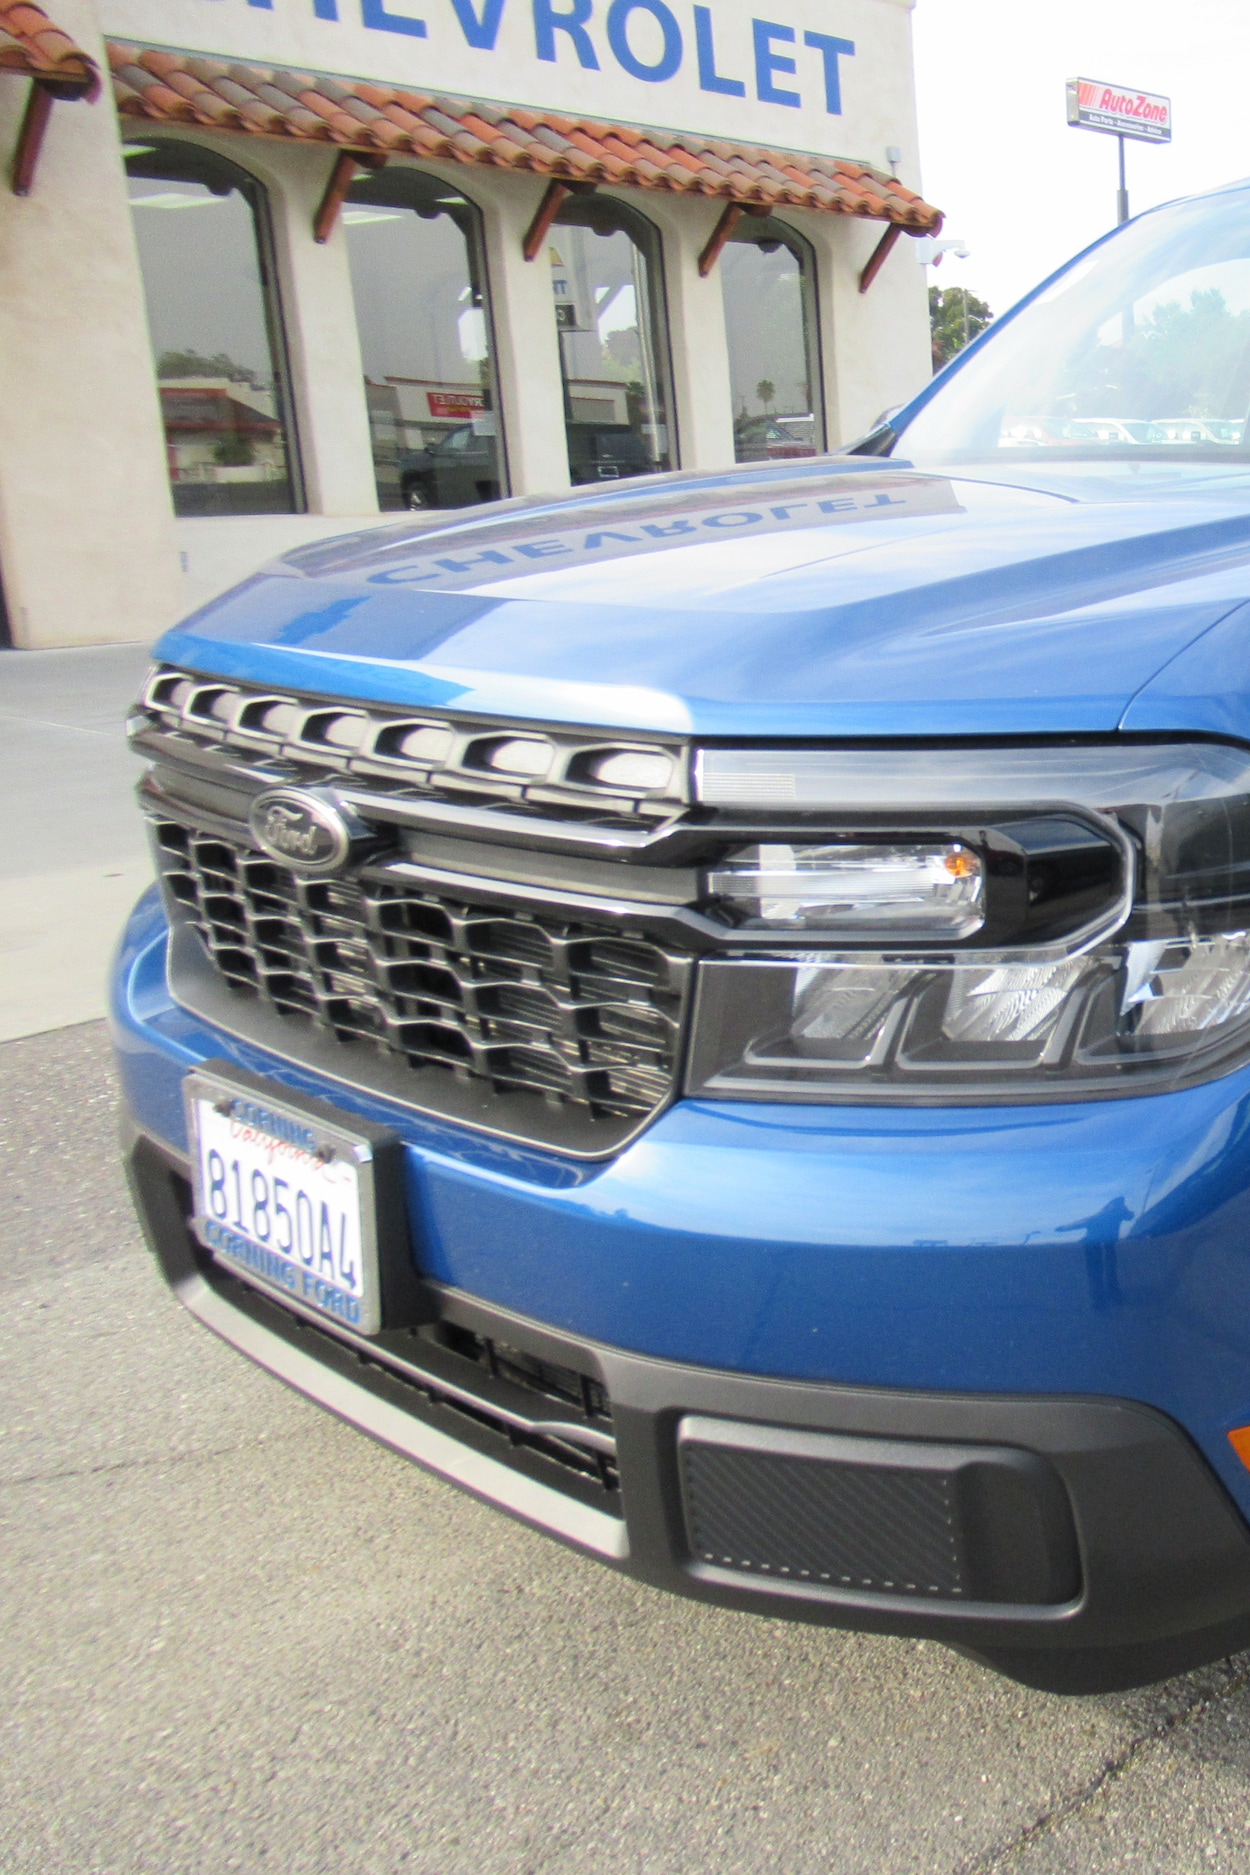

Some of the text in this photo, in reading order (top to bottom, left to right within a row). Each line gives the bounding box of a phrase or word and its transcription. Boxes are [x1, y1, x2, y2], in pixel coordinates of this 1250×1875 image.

[199, 0, 855, 116] VROLET
[1099, 88, 1168, 123] AutoZone
[205, 1218, 360, 1325] CORNING FORD
[208, 1148, 357, 1291] 81850A4
